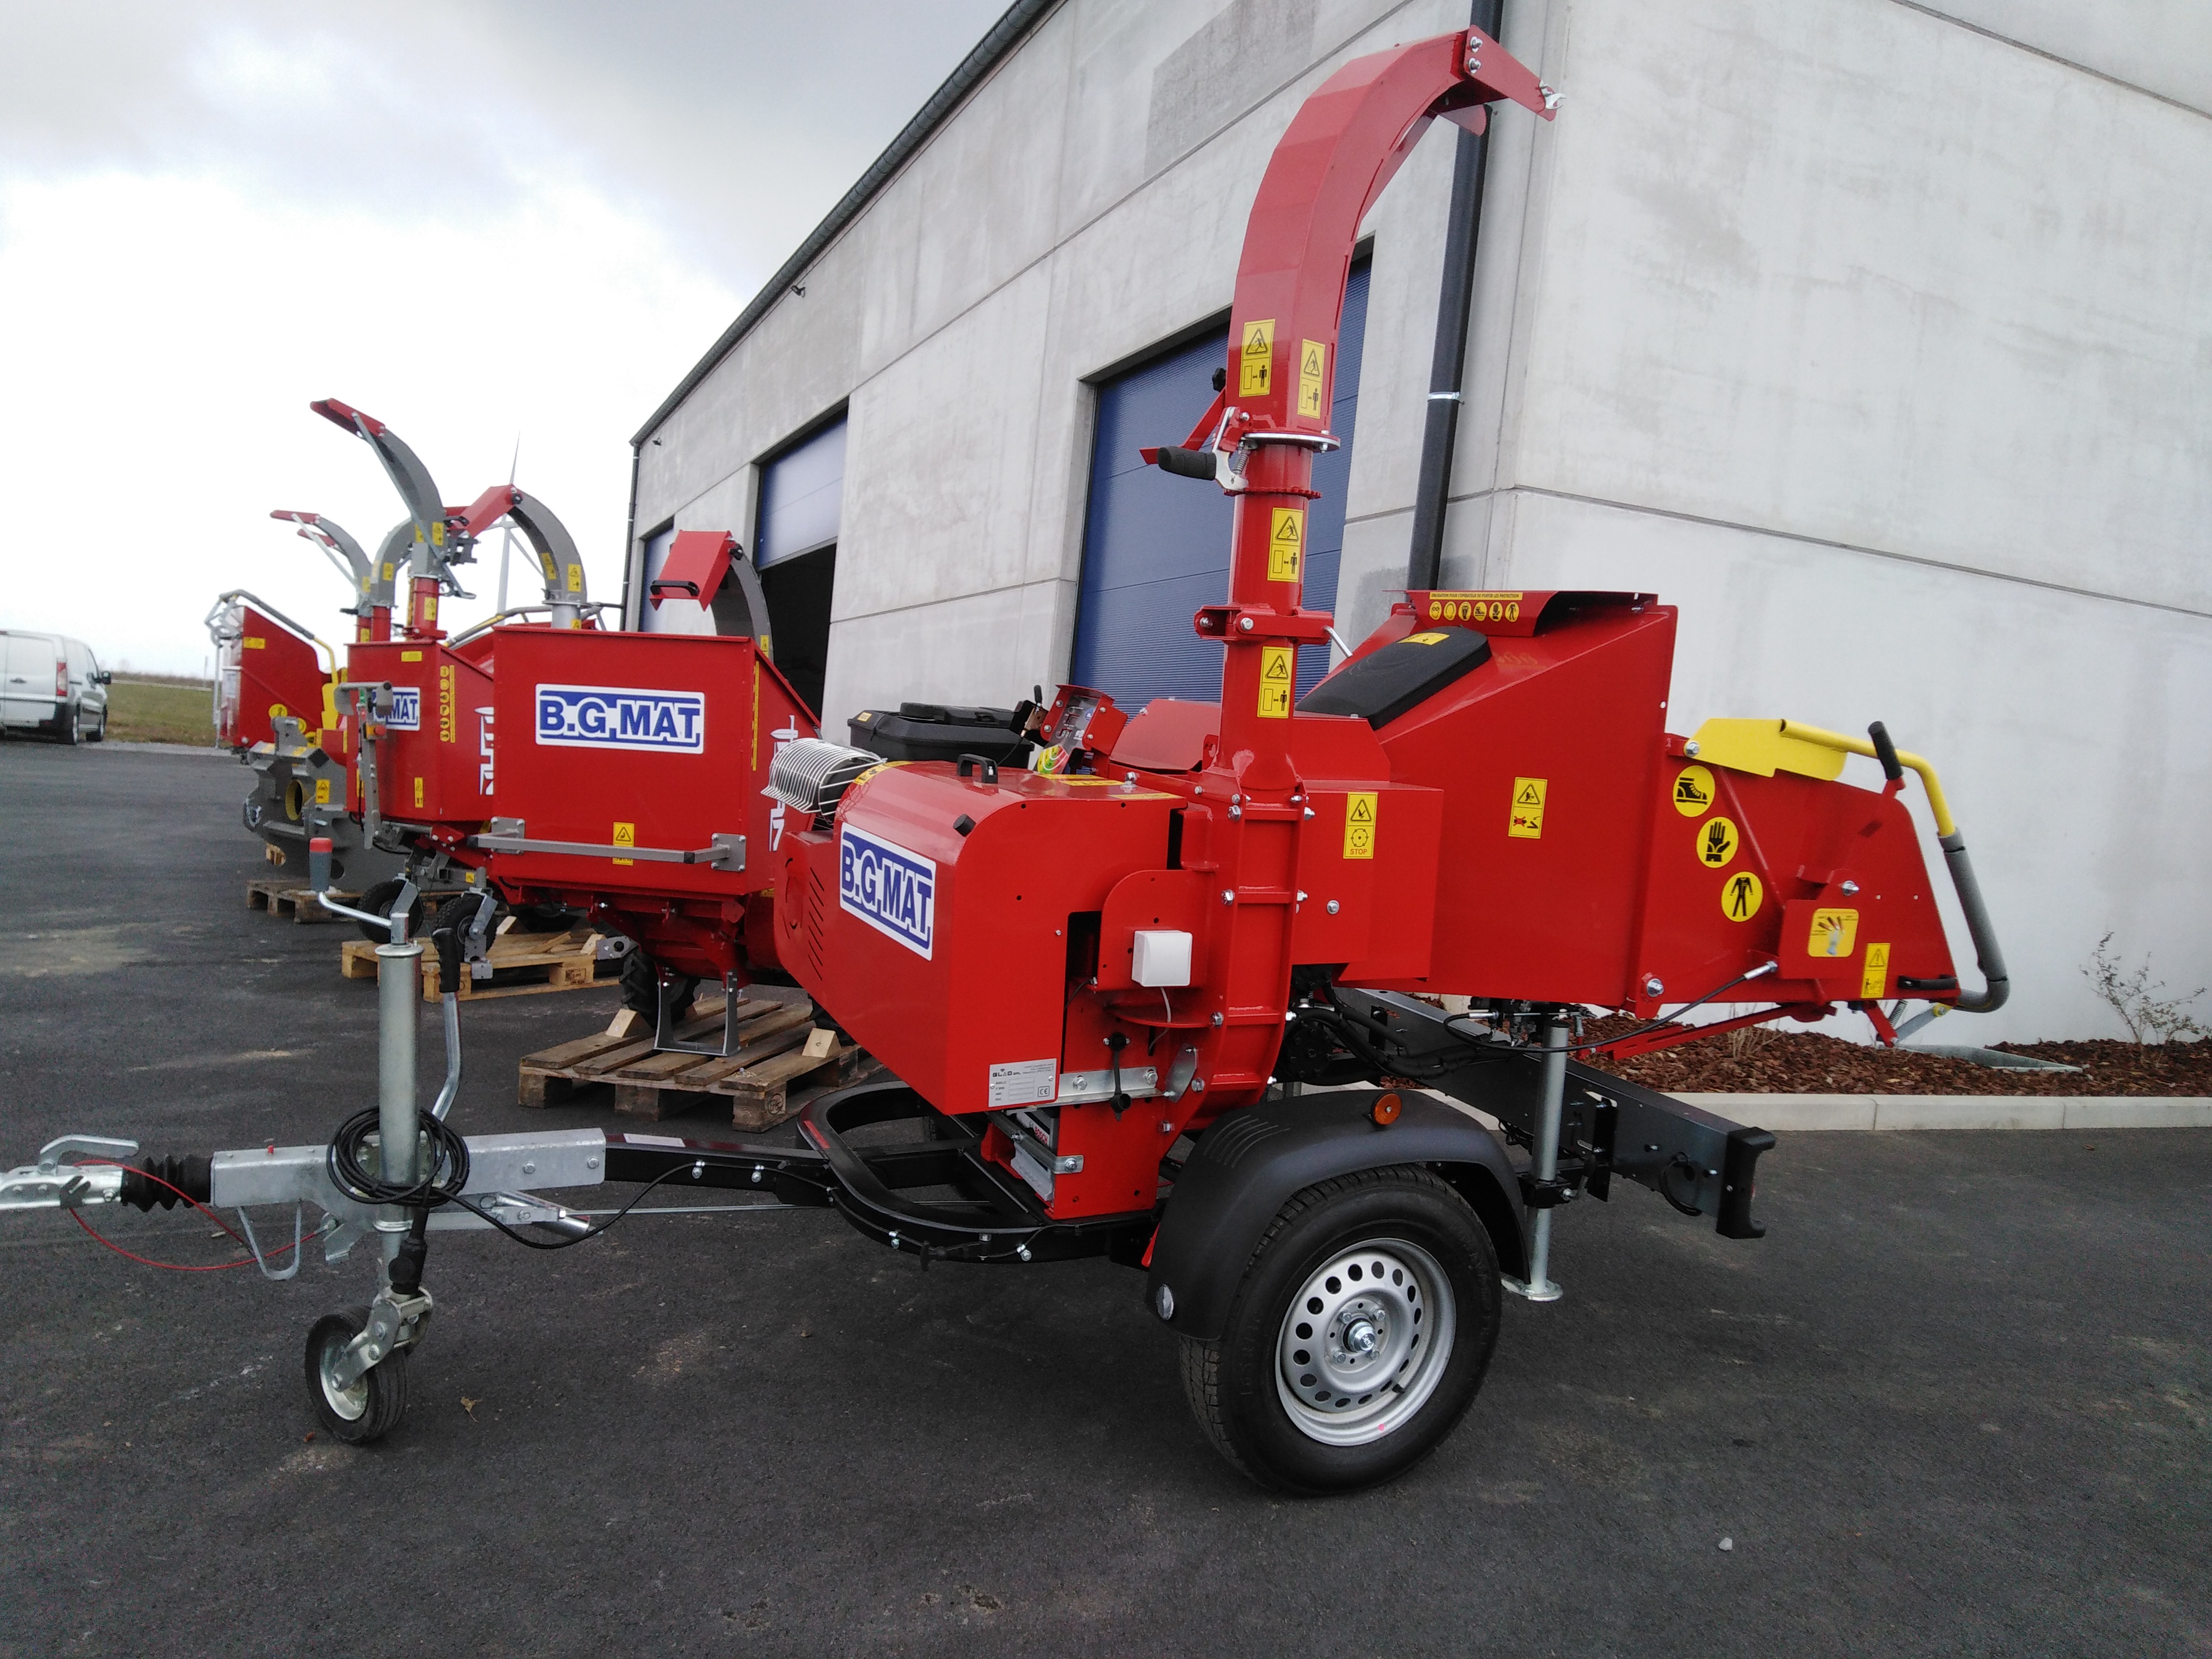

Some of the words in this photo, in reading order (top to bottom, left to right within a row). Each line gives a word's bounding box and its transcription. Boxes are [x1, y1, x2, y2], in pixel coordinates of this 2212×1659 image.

[540, 700, 700, 739] B.G.MAT
[842, 844, 932, 935] B.G.MAT
[1034, 1126, 1048, 1145] BOSCH
